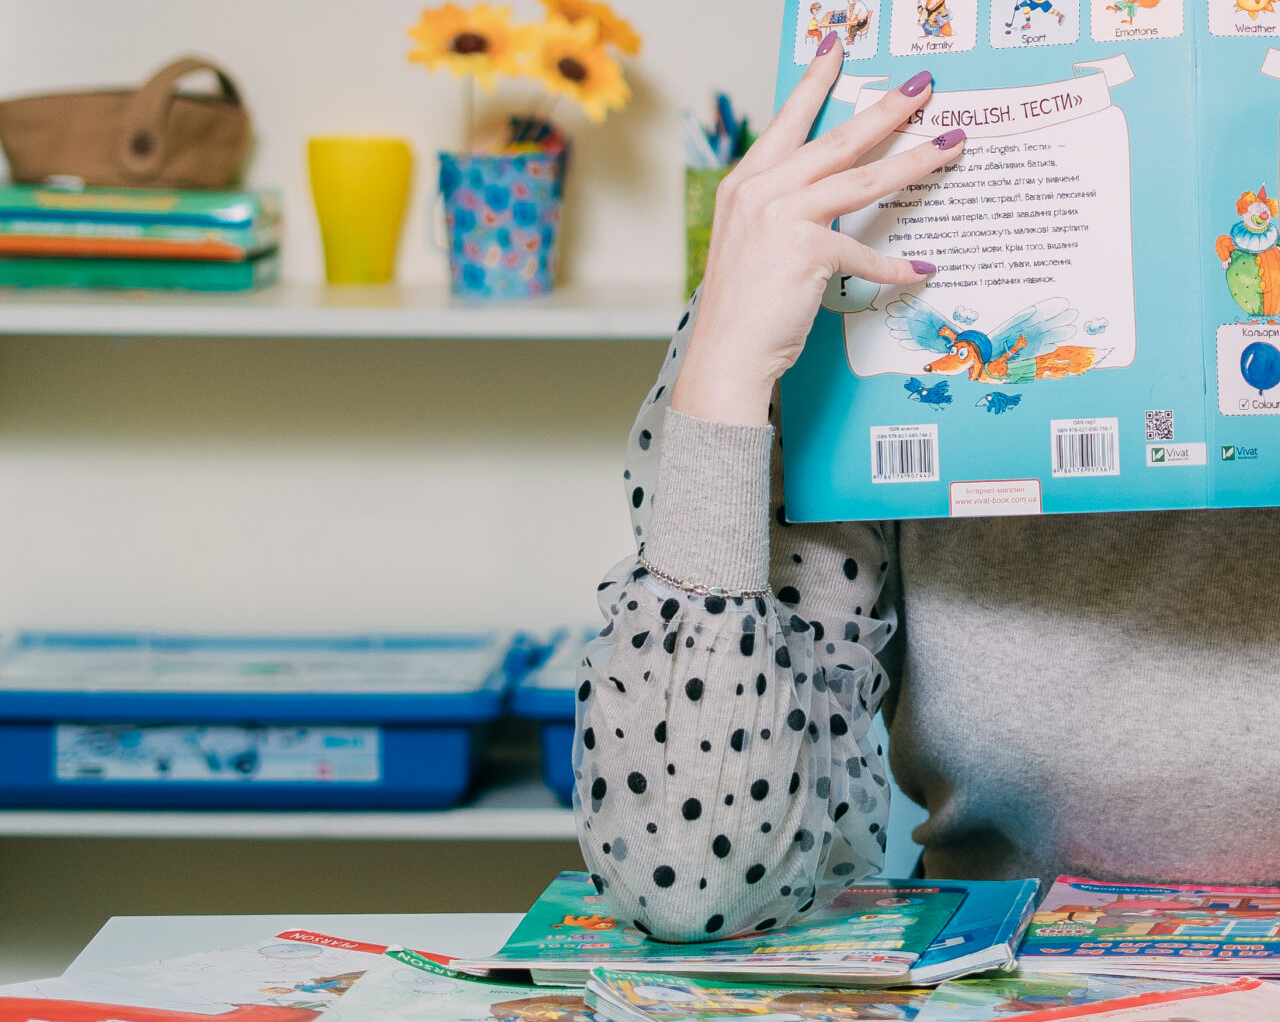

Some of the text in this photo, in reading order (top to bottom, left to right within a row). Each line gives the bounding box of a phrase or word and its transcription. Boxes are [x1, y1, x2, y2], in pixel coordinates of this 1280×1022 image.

[1115, 28, 1158, 37] Emotions
[1235, 24, 1277, 33] Weather
[1021, 34, 1046, 45] Sport
[911, 41, 954, 53] My family
[931, 105, 1015, 126] «ENGLISH.
[1020, 92, 1083, 119] ТЕСТИ»
[944, 163, 965, 173] вибір
[967, 164, 983, 172] для
[906, 183, 941, 193] прагнуть
[943, 181, 985, 189] допомогти
[987, 178, 1012, 186] своїм
[1014, 177, 1035, 186] дітям
[914, 230, 959, 240] складності
[961, 227, 1011, 238] допоможуть
[937, 262, 976, 273] розвитку
[1242, 328, 1280, 339] Кольори
[1166, 448, 1189, 458] Vivat
[1236, 447, 1258, 456] Vivat
[955, 497, 1037, 505] www.vivat-book.com.ua
[290, 932, 359, 949] PEARSON
[1079, 942, 1265, 951] ШКОЛИ
[397, 952, 478, 981] PEARSON
[603, 971, 689, 985] PEARSON
